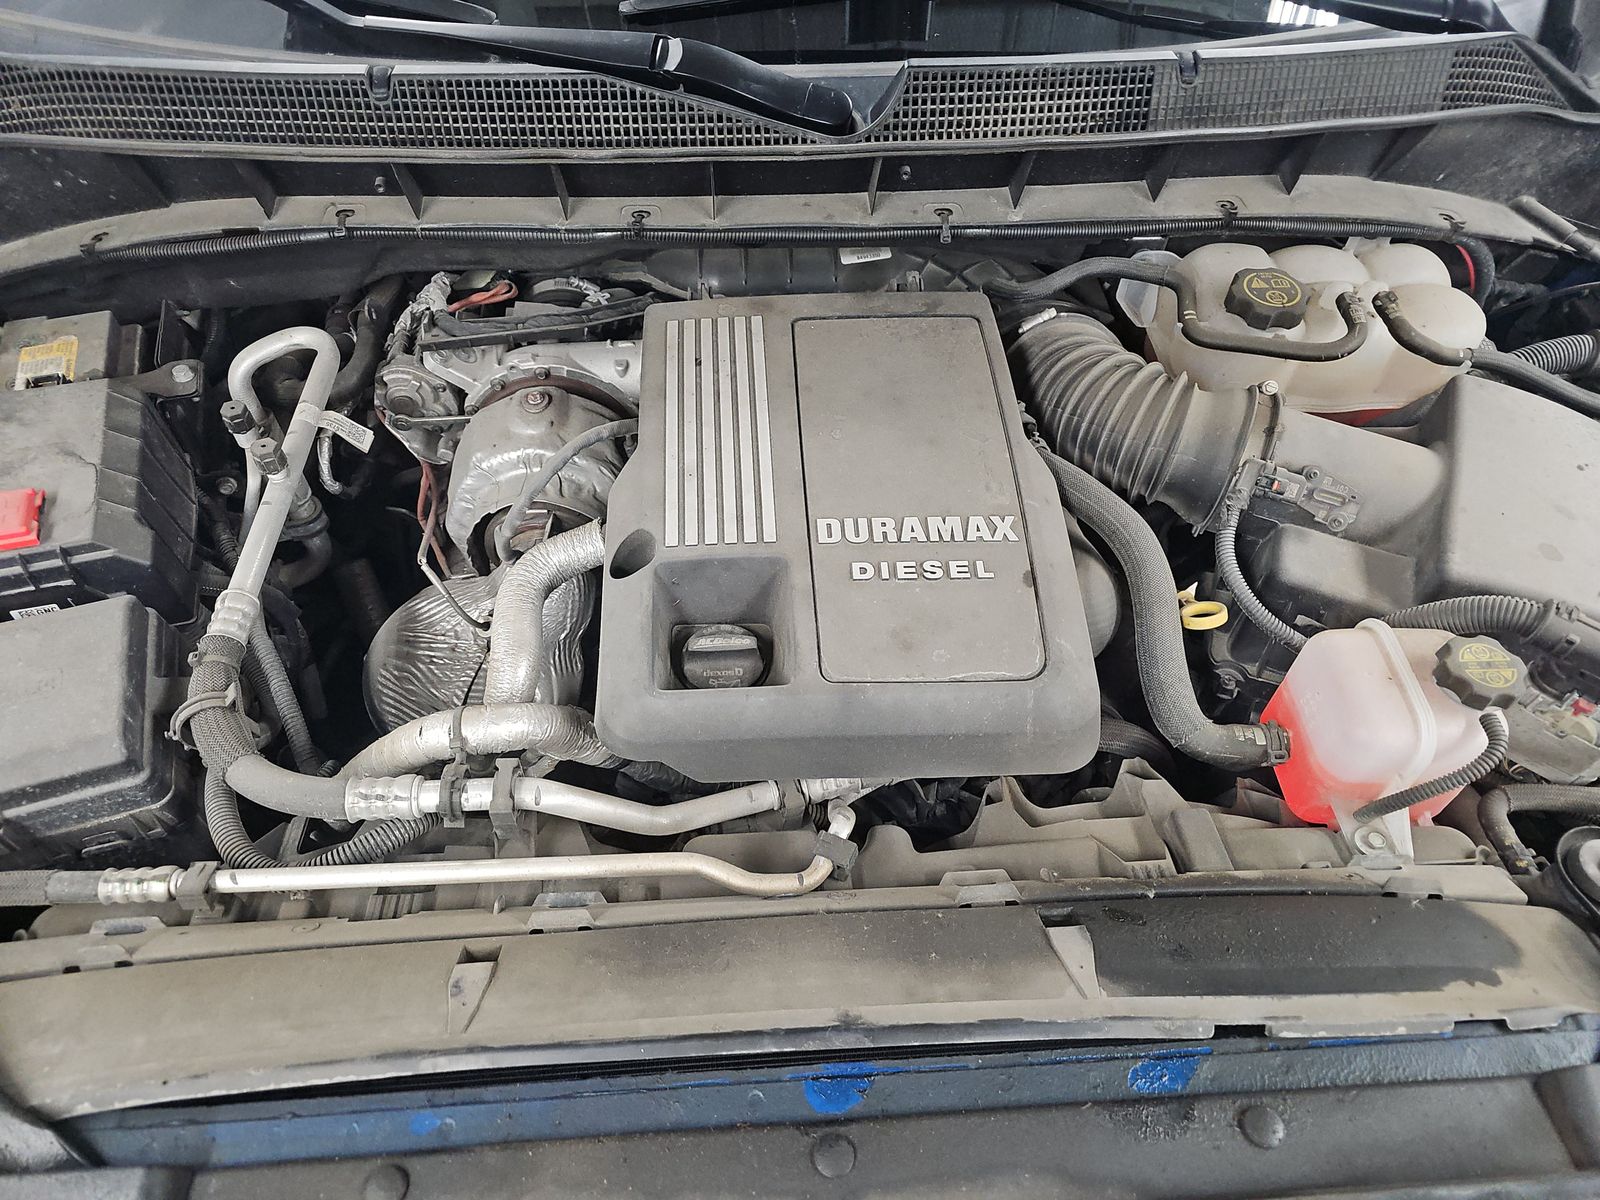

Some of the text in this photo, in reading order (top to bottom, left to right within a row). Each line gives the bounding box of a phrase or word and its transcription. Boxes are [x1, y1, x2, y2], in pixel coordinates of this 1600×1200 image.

[816, 515, 1020, 544] DURAMAX
[851, 560, 995, 581] DIESEL
[695, 636, 751, 647] ACDelco
